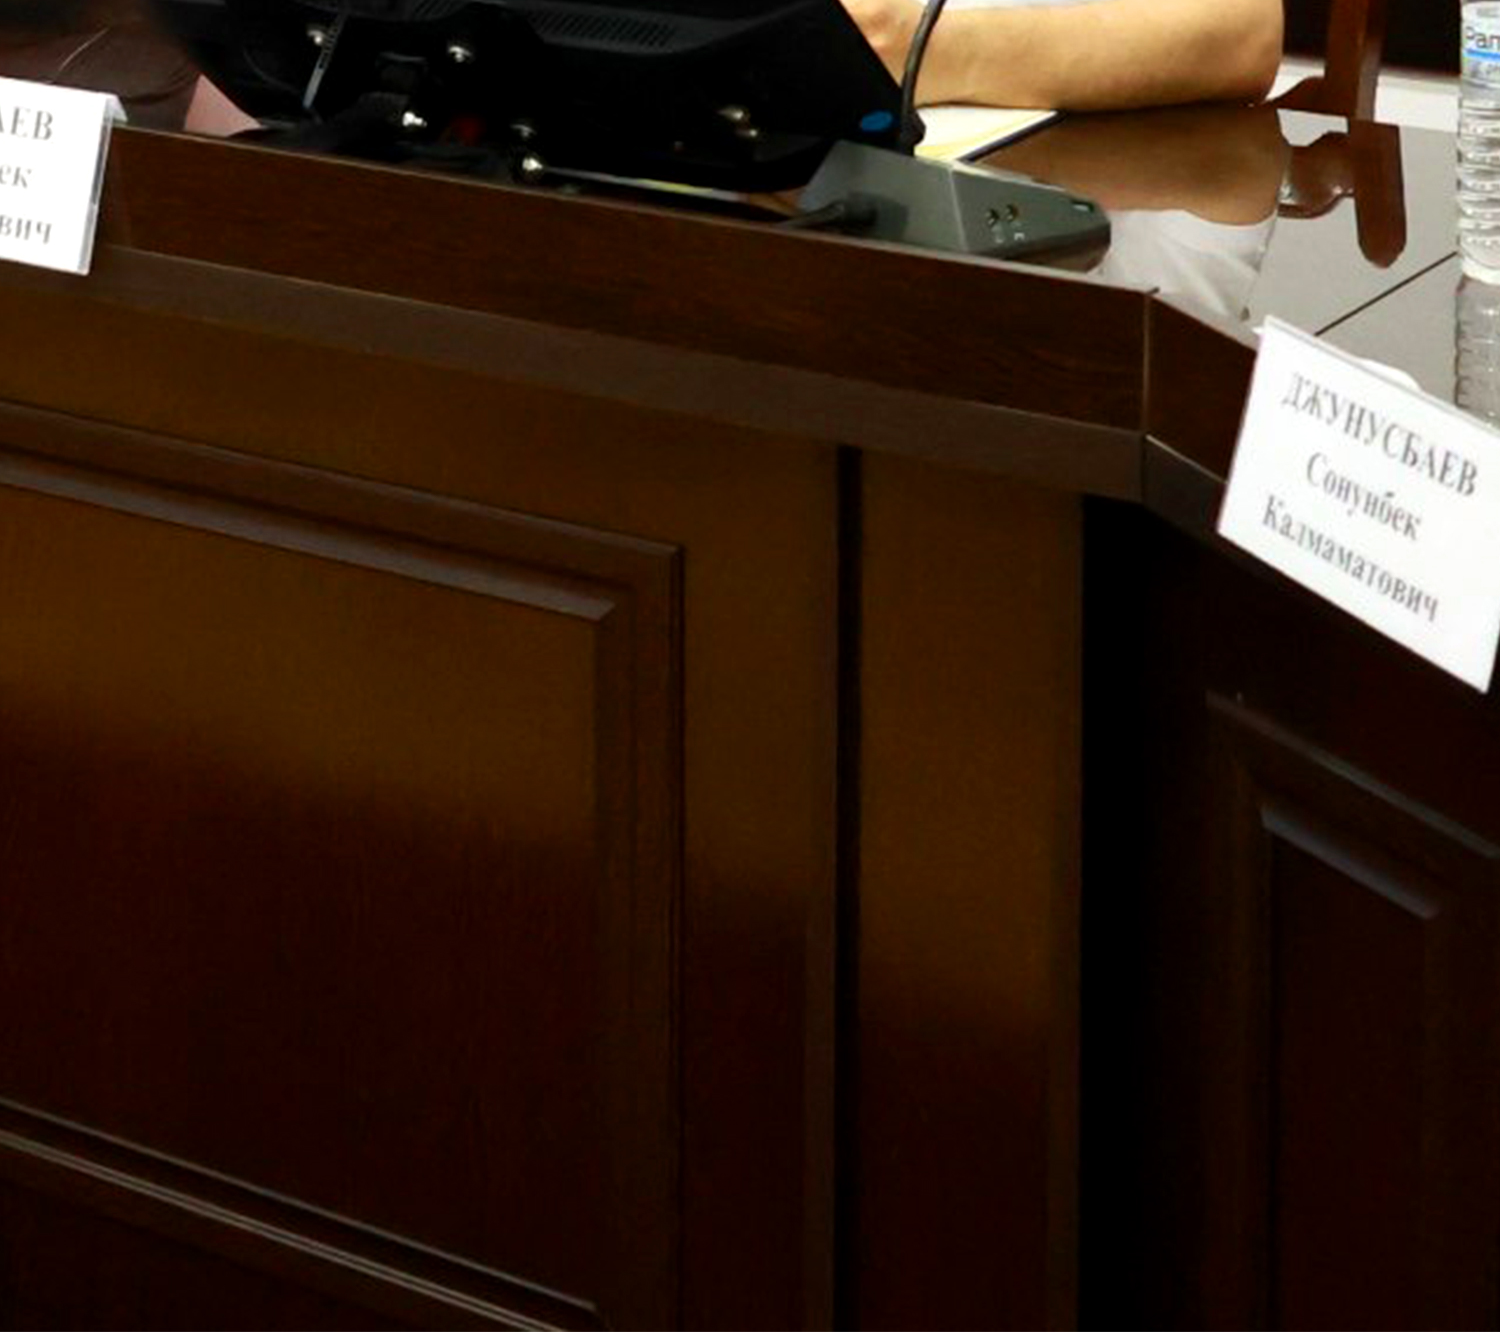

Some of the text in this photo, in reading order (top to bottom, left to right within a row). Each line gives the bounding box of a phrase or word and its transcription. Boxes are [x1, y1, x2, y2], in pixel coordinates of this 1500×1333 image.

[1281, 371, 1478, 498] ДЖУНУСБАЕВ
[1306, 451, 1422, 542] Сонунбек
[1261, 494, 1440, 623] Калмаматович
